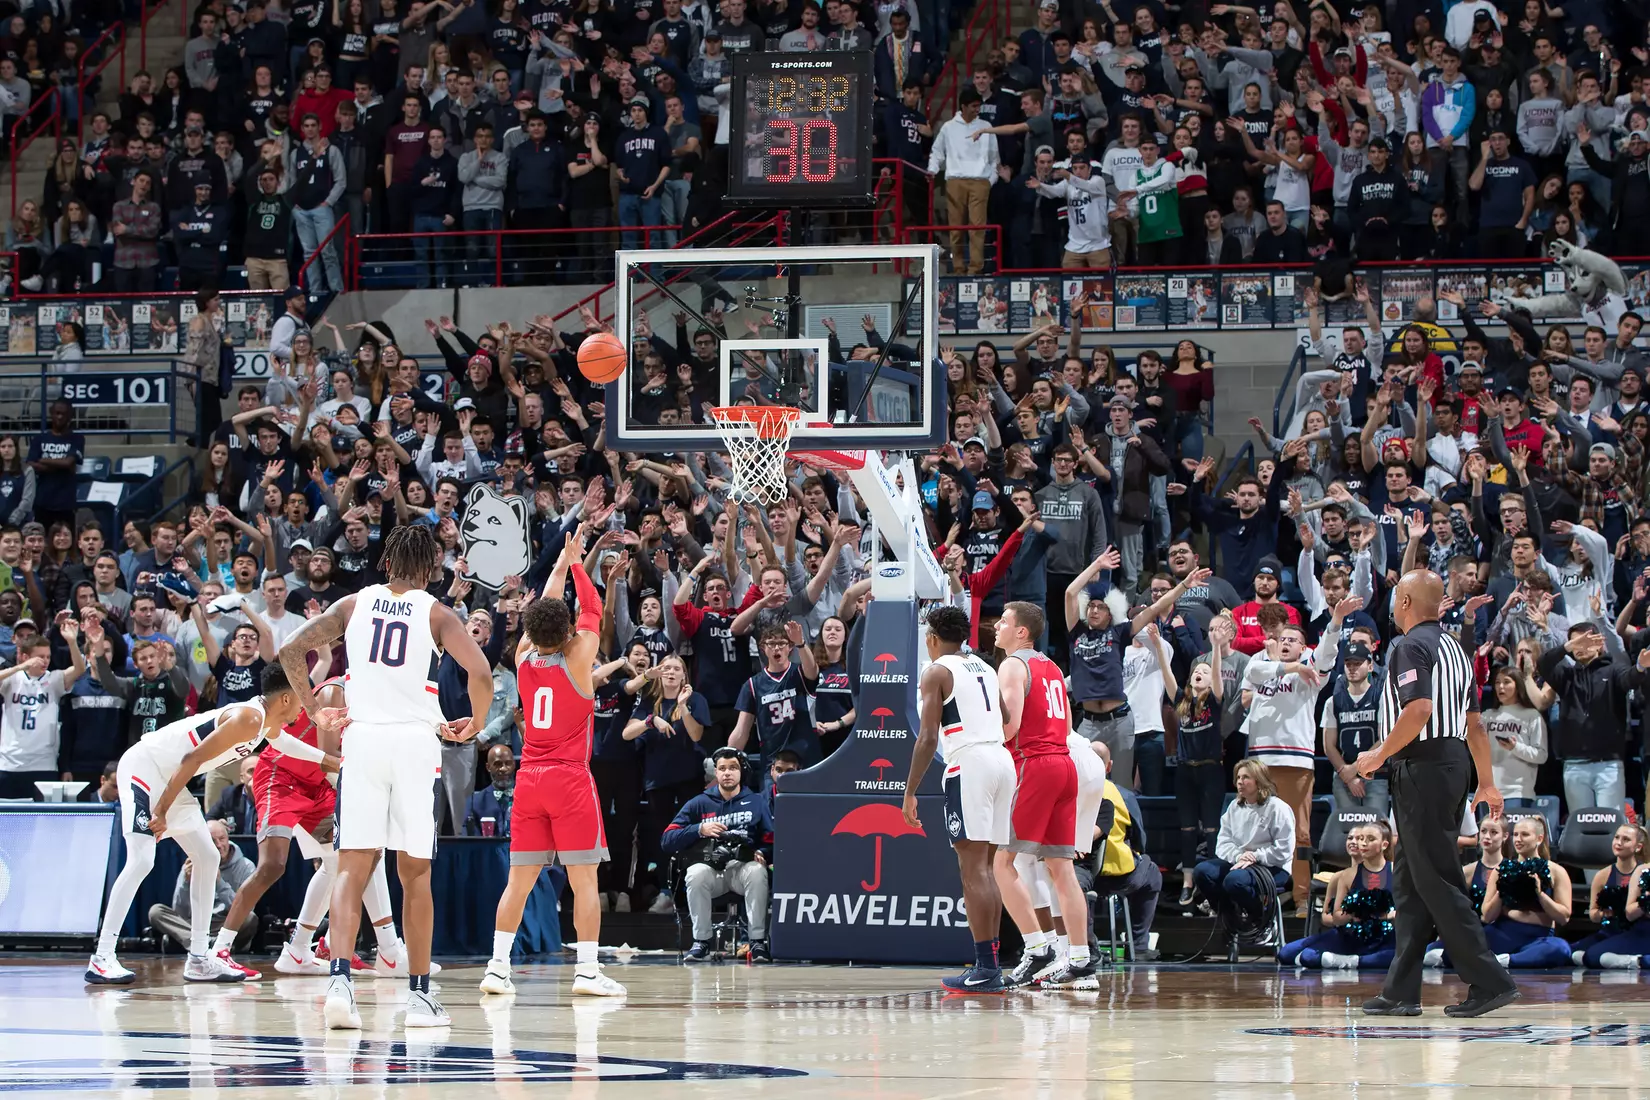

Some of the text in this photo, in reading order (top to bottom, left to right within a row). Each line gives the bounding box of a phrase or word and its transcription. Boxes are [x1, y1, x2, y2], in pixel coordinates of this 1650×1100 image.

[771, 61, 833, 69] TS-SPORTS.COM
[754, 76, 849, 113] 12:32
[1244, 121, 1269, 134] CONN
[624, 138, 657, 154] UCONN
[763, 120, 838, 183] 30
[297, 159, 324, 170] UCN
[1485, 166, 1520, 175] UCONN
[1361, 183, 1394, 194] UCONN
[1145, 195, 1158, 214] 0
[260, 214, 276, 230] 8
[1075, 208, 1087, 225] 15
[1172, 280, 1184, 290] 20
[43, 306, 53, 317] 21
[89, 307, 101, 317] 52
[136, 306, 149, 316] 42
[1301, 334, 1338, 349] SC
[233, 353, 269, 376] 20
[64, 377, 166, 403] SEC 101
[367, 478, 390, 490] UCO
[1042, 504, 1083, 516] UCONN
[967, 543, 999, 555] UCONN
[371, 598, 413, 616] ADAMS
[368, 617, 409, 668] 10
[720, 636, 737, 663] 15
[964, 660, 987, 674] VITAL
[859, 674, 910, 684] TRAVELERS
[13, 693, 50, 706] UCONN
[976, 676, 993, 712] 1
[532, 686, 553, 730] 0
[769, 699, 797, 725] 34
[22, 709, 37, 731] 15
[1338, 710, 1376, 724] CONNECTICUT
[856, 729, 908, 740] TRAVELERS
[1353, 730, 1361, 748] 4
[854, 781, 907, 791] TRAVELERS
[1338, 813, 1377, 823] UCONN
[1576, 813, 1617, 823] UCONN
[773, 892, 970, 927] TRAVELERS
